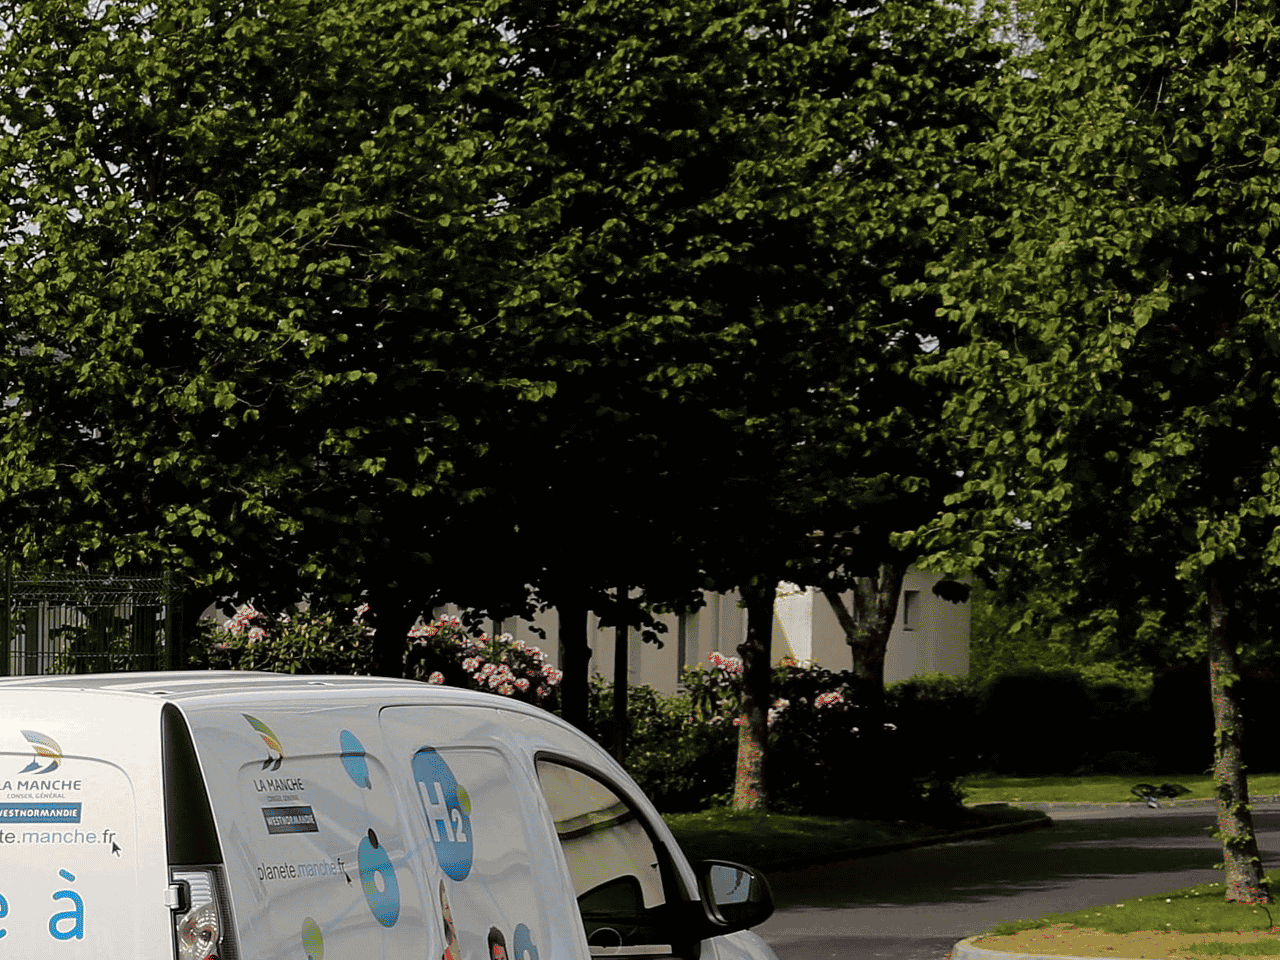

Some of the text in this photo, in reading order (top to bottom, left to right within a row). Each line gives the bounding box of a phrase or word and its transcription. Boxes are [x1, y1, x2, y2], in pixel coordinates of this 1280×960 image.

[17, 780, 82, 791] MANCHE
[253, 778, 305, 792] LA MANCHE
[48, 869, 85, 941] à
